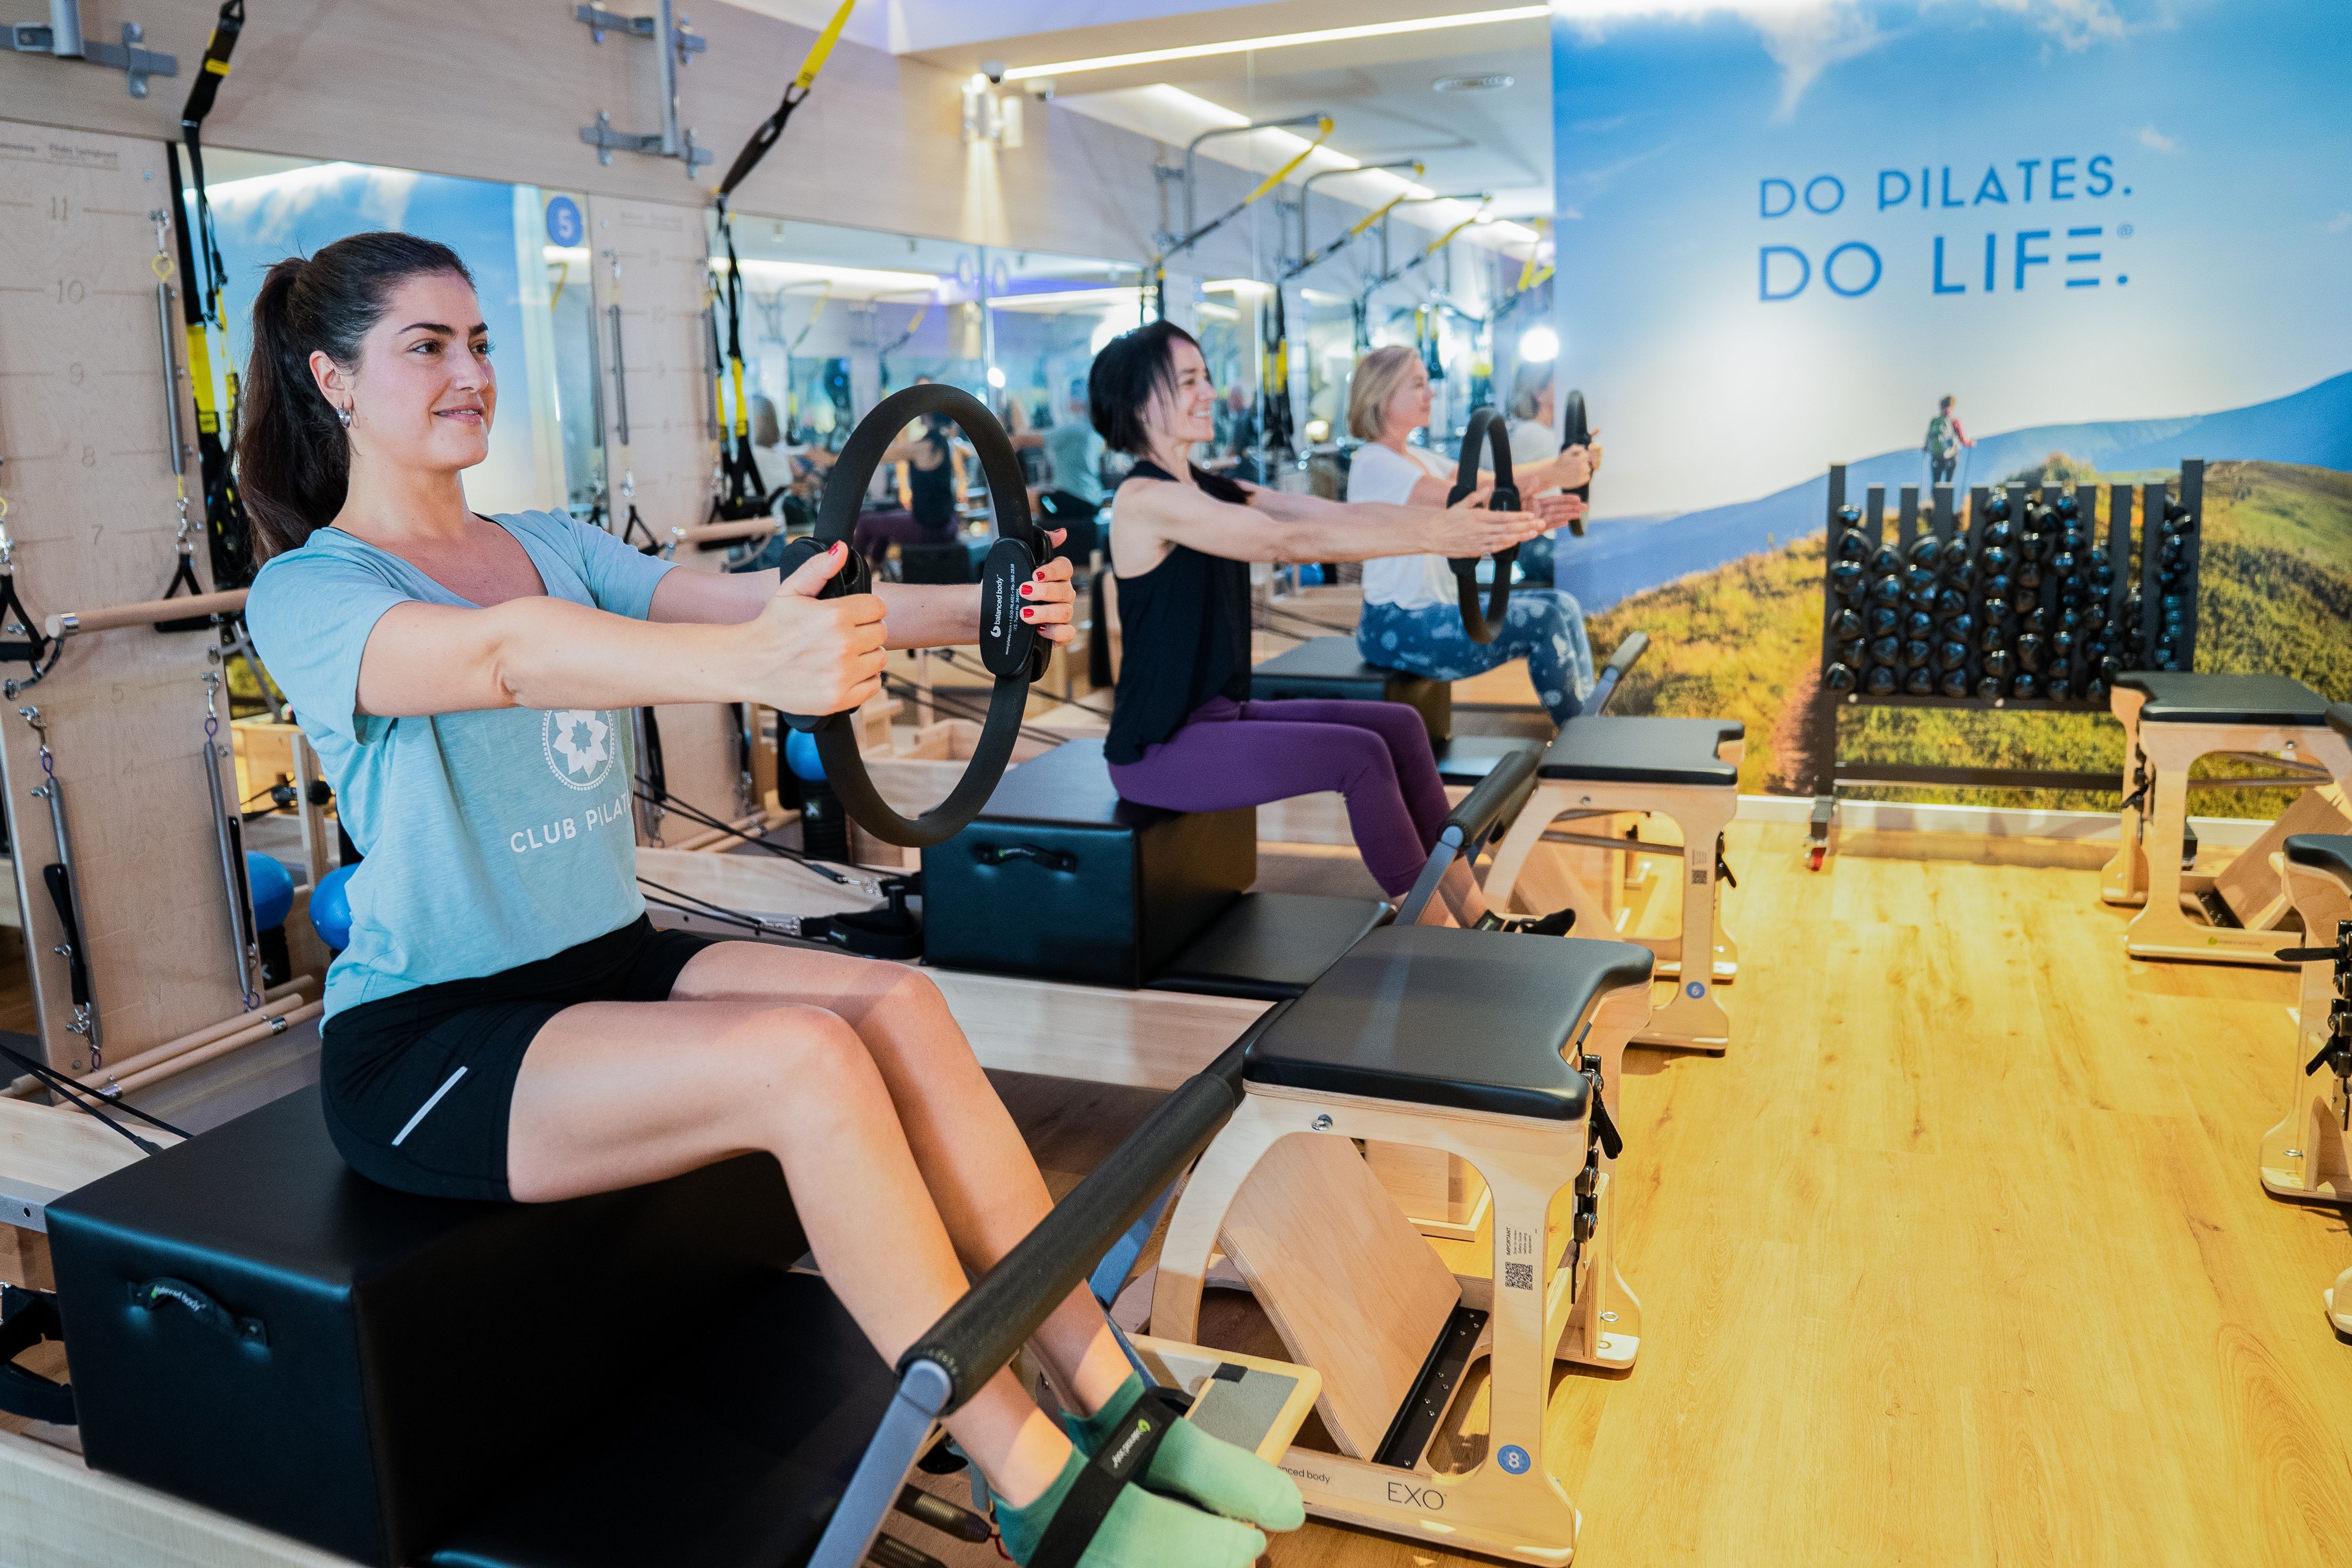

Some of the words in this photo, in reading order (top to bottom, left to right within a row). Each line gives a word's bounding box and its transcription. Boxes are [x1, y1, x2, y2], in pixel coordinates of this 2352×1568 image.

[1760, 175, 1845, 218] DO
[1878, 153, 2132, 212] PILATES.
[50, 197, 69, 222] 11
[559, 207, 573, 238] 5
[1759, 240, 1883, 302] DO
[56, 279, 85, 304] 10
[70, 361, 84, 386] 9
[82, 446, 96, 468] 8
[92, 524, 105, 546] 7
[510, 818, 577, 854] CLUB
[1508, 1452, 1520, 1468] 8
[1307, 1470, 1331, 1484] body
[1387, 1481, 1445, 1510] EXO
